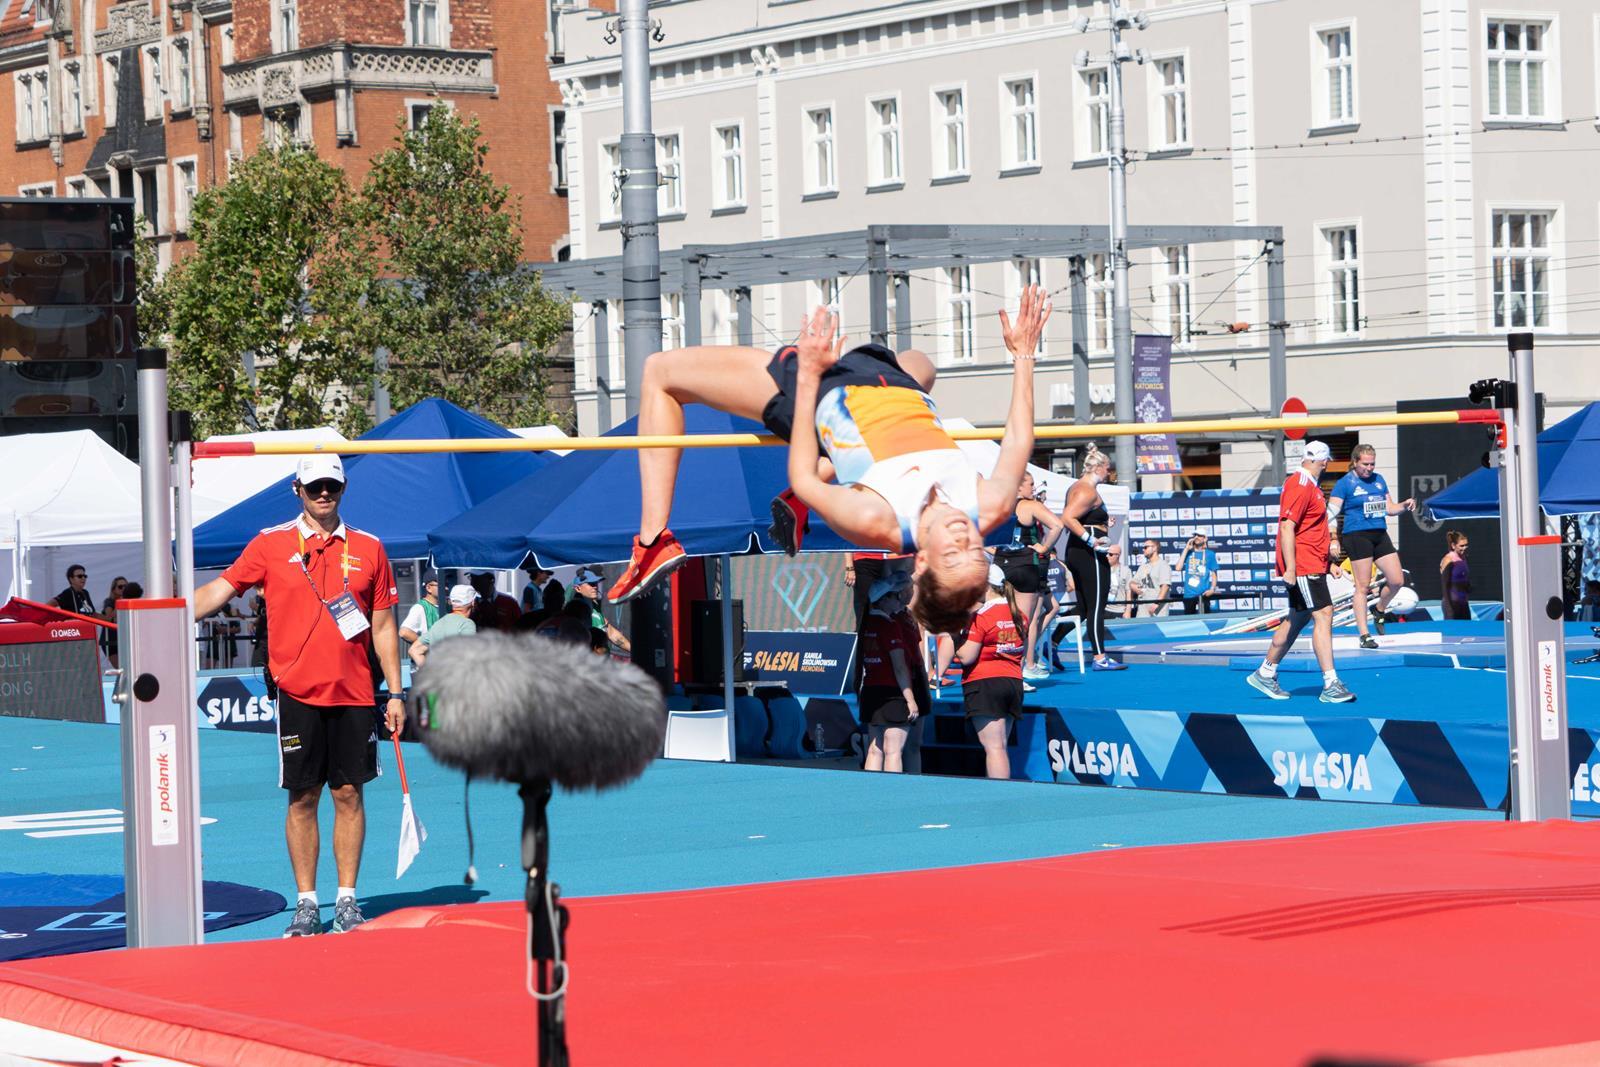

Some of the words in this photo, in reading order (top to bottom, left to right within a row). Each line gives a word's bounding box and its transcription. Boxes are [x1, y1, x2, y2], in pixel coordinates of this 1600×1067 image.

[58, 629, 80, 637] OMEGA
[23, 652, 31, 666] H
[752, 650, 800, 672] SILESIA
[0, 682, 20, 697] ON
[23, 681, 33, 696] G
[1543, 663, 1555, 713] polanik
[1048, 739, 1139, 777] SILESIA
[1272, 750, 1373, 792] SILESIA
[157, 752, 173, 813] polanik
